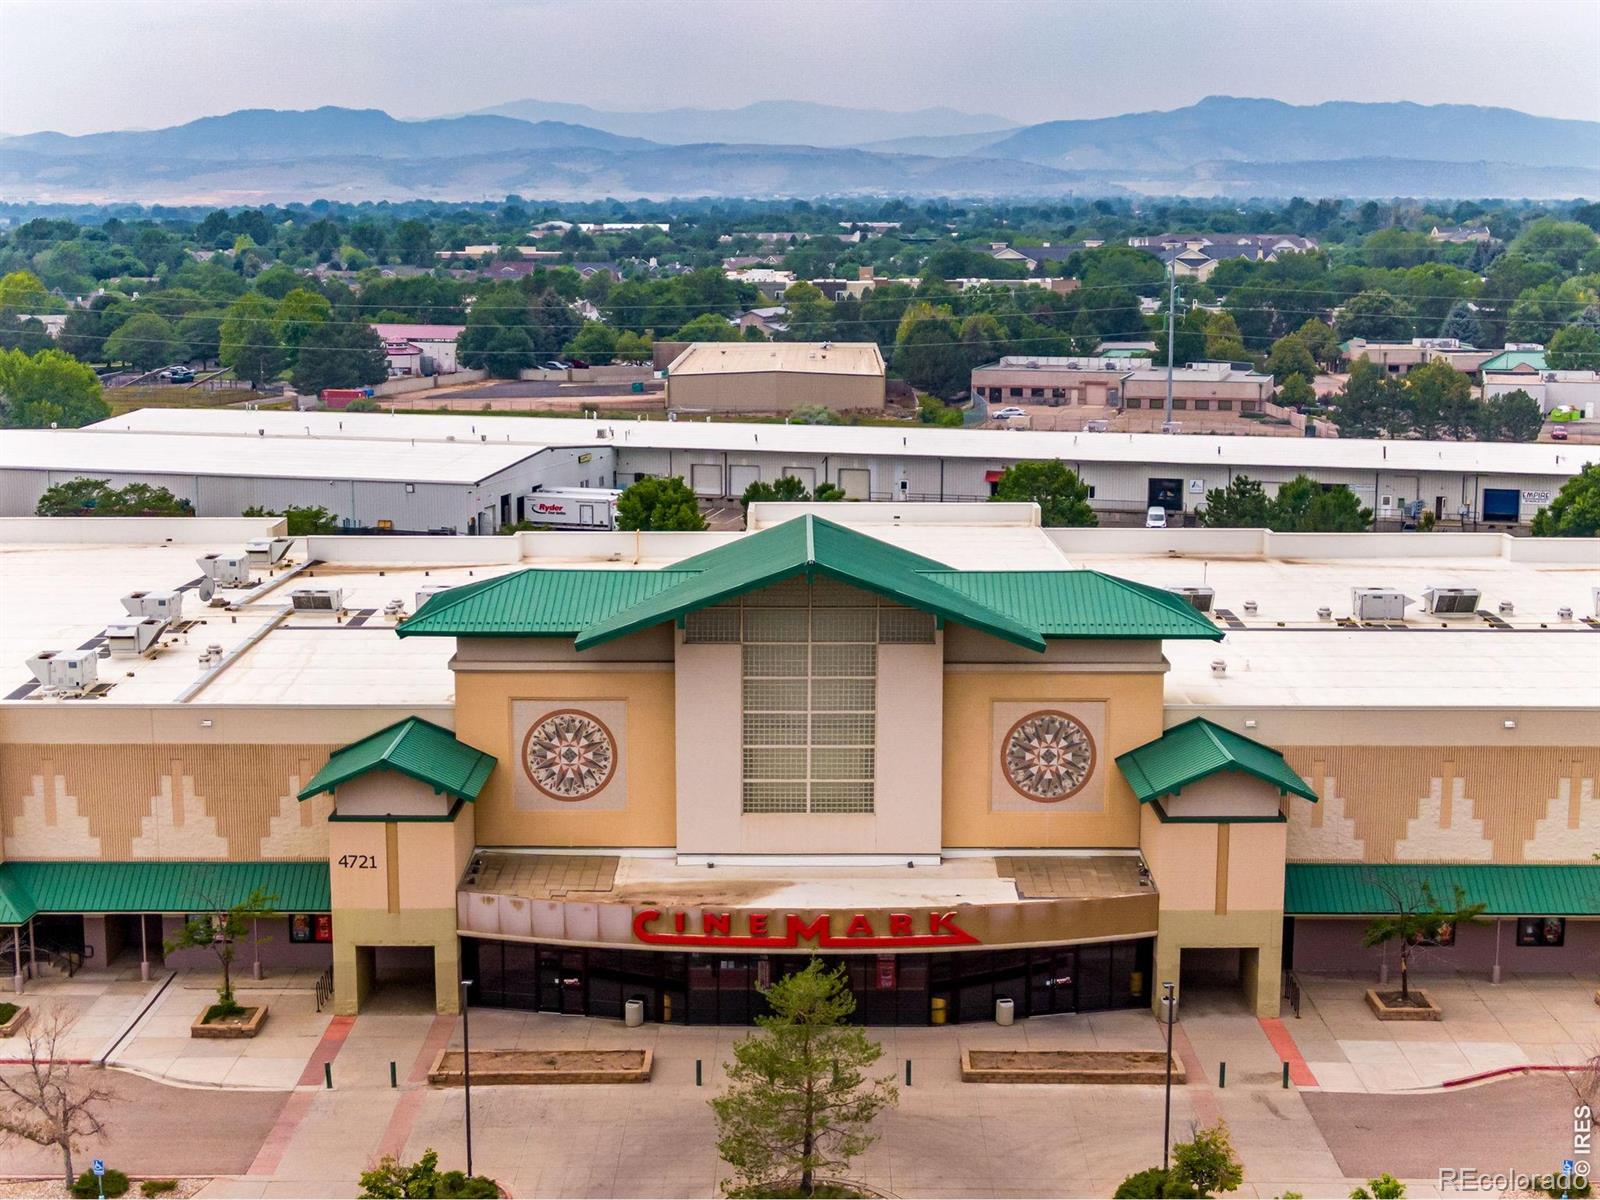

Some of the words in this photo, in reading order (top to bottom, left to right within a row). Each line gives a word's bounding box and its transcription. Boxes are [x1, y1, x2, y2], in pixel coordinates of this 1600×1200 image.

[1522, 491, 1550, 499] EMPIRE
[539, 503, 563, 512] Ryder
[338, 854, 377, 869] 4721
[632, 908, 981, 947] CINEMARK
